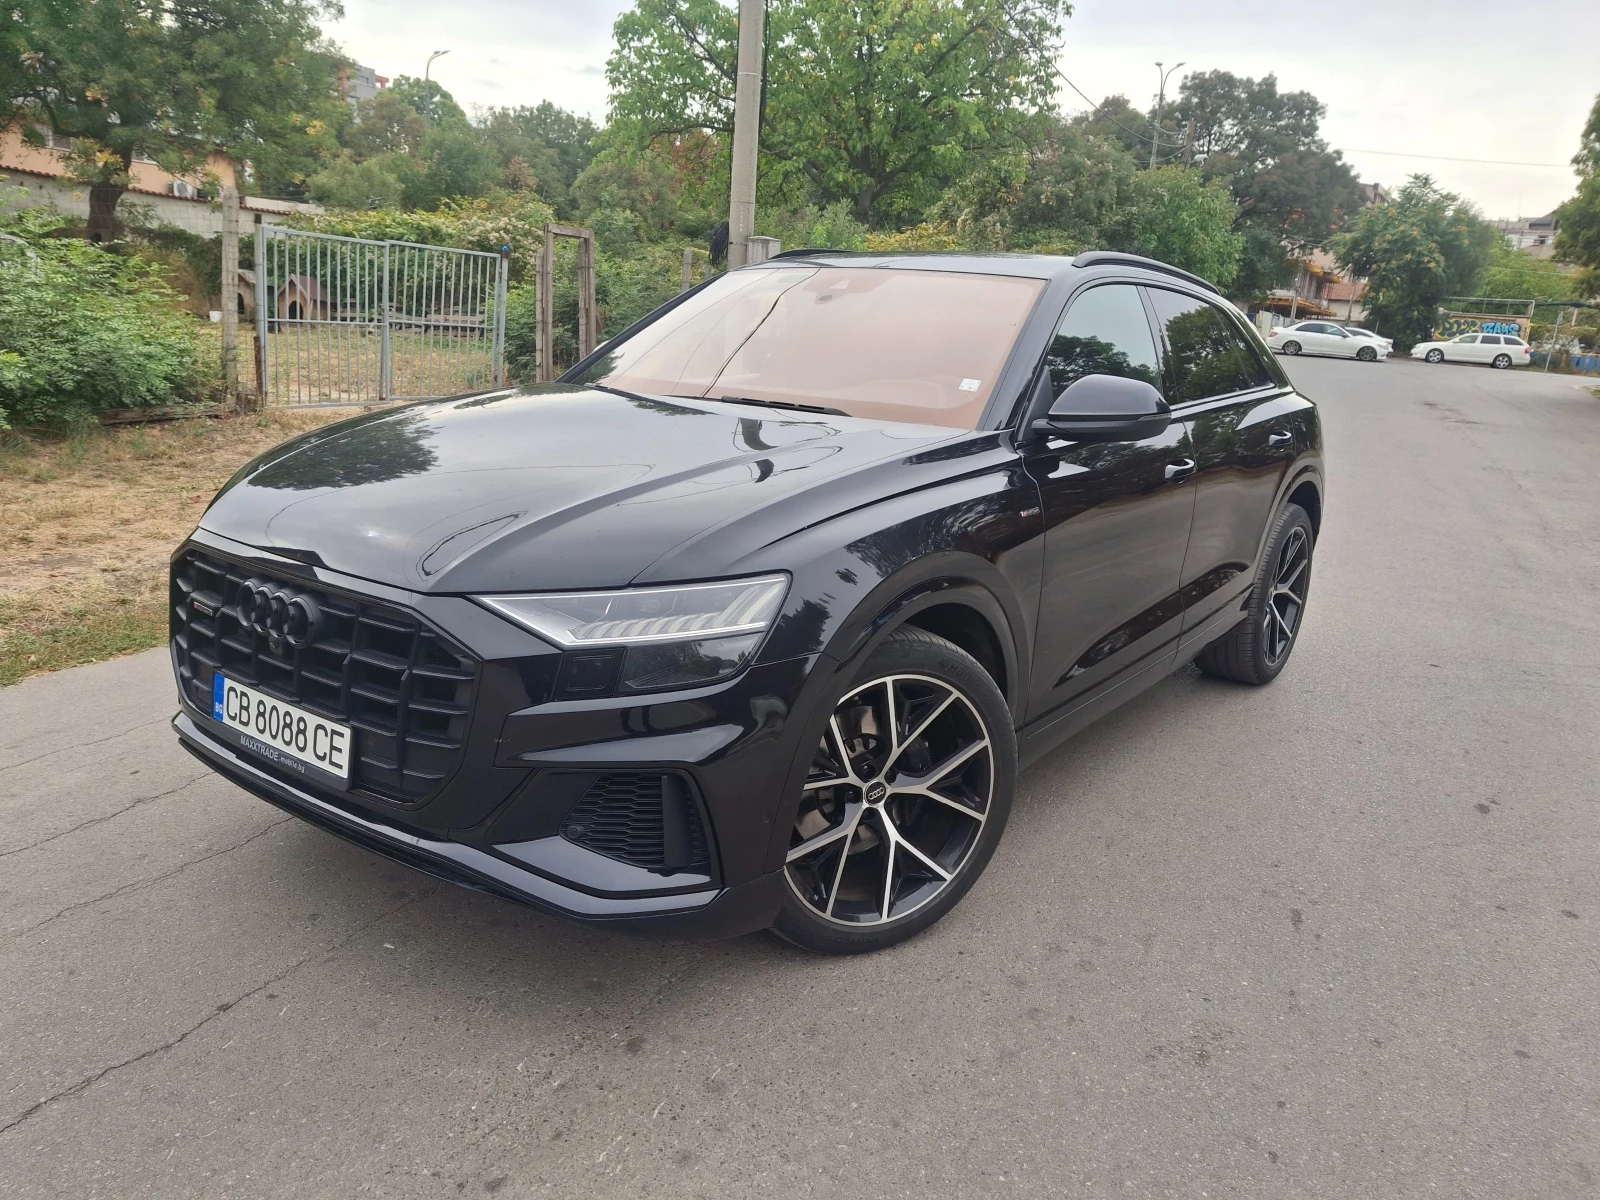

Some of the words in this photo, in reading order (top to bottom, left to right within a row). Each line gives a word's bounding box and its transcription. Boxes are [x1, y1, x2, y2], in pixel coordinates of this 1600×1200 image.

[215, 701, 223, 714] BG
[226, 686, 251, 727] CB
[255, 699, 308, 753] 8088
[312, 723, 345, 770] CE
